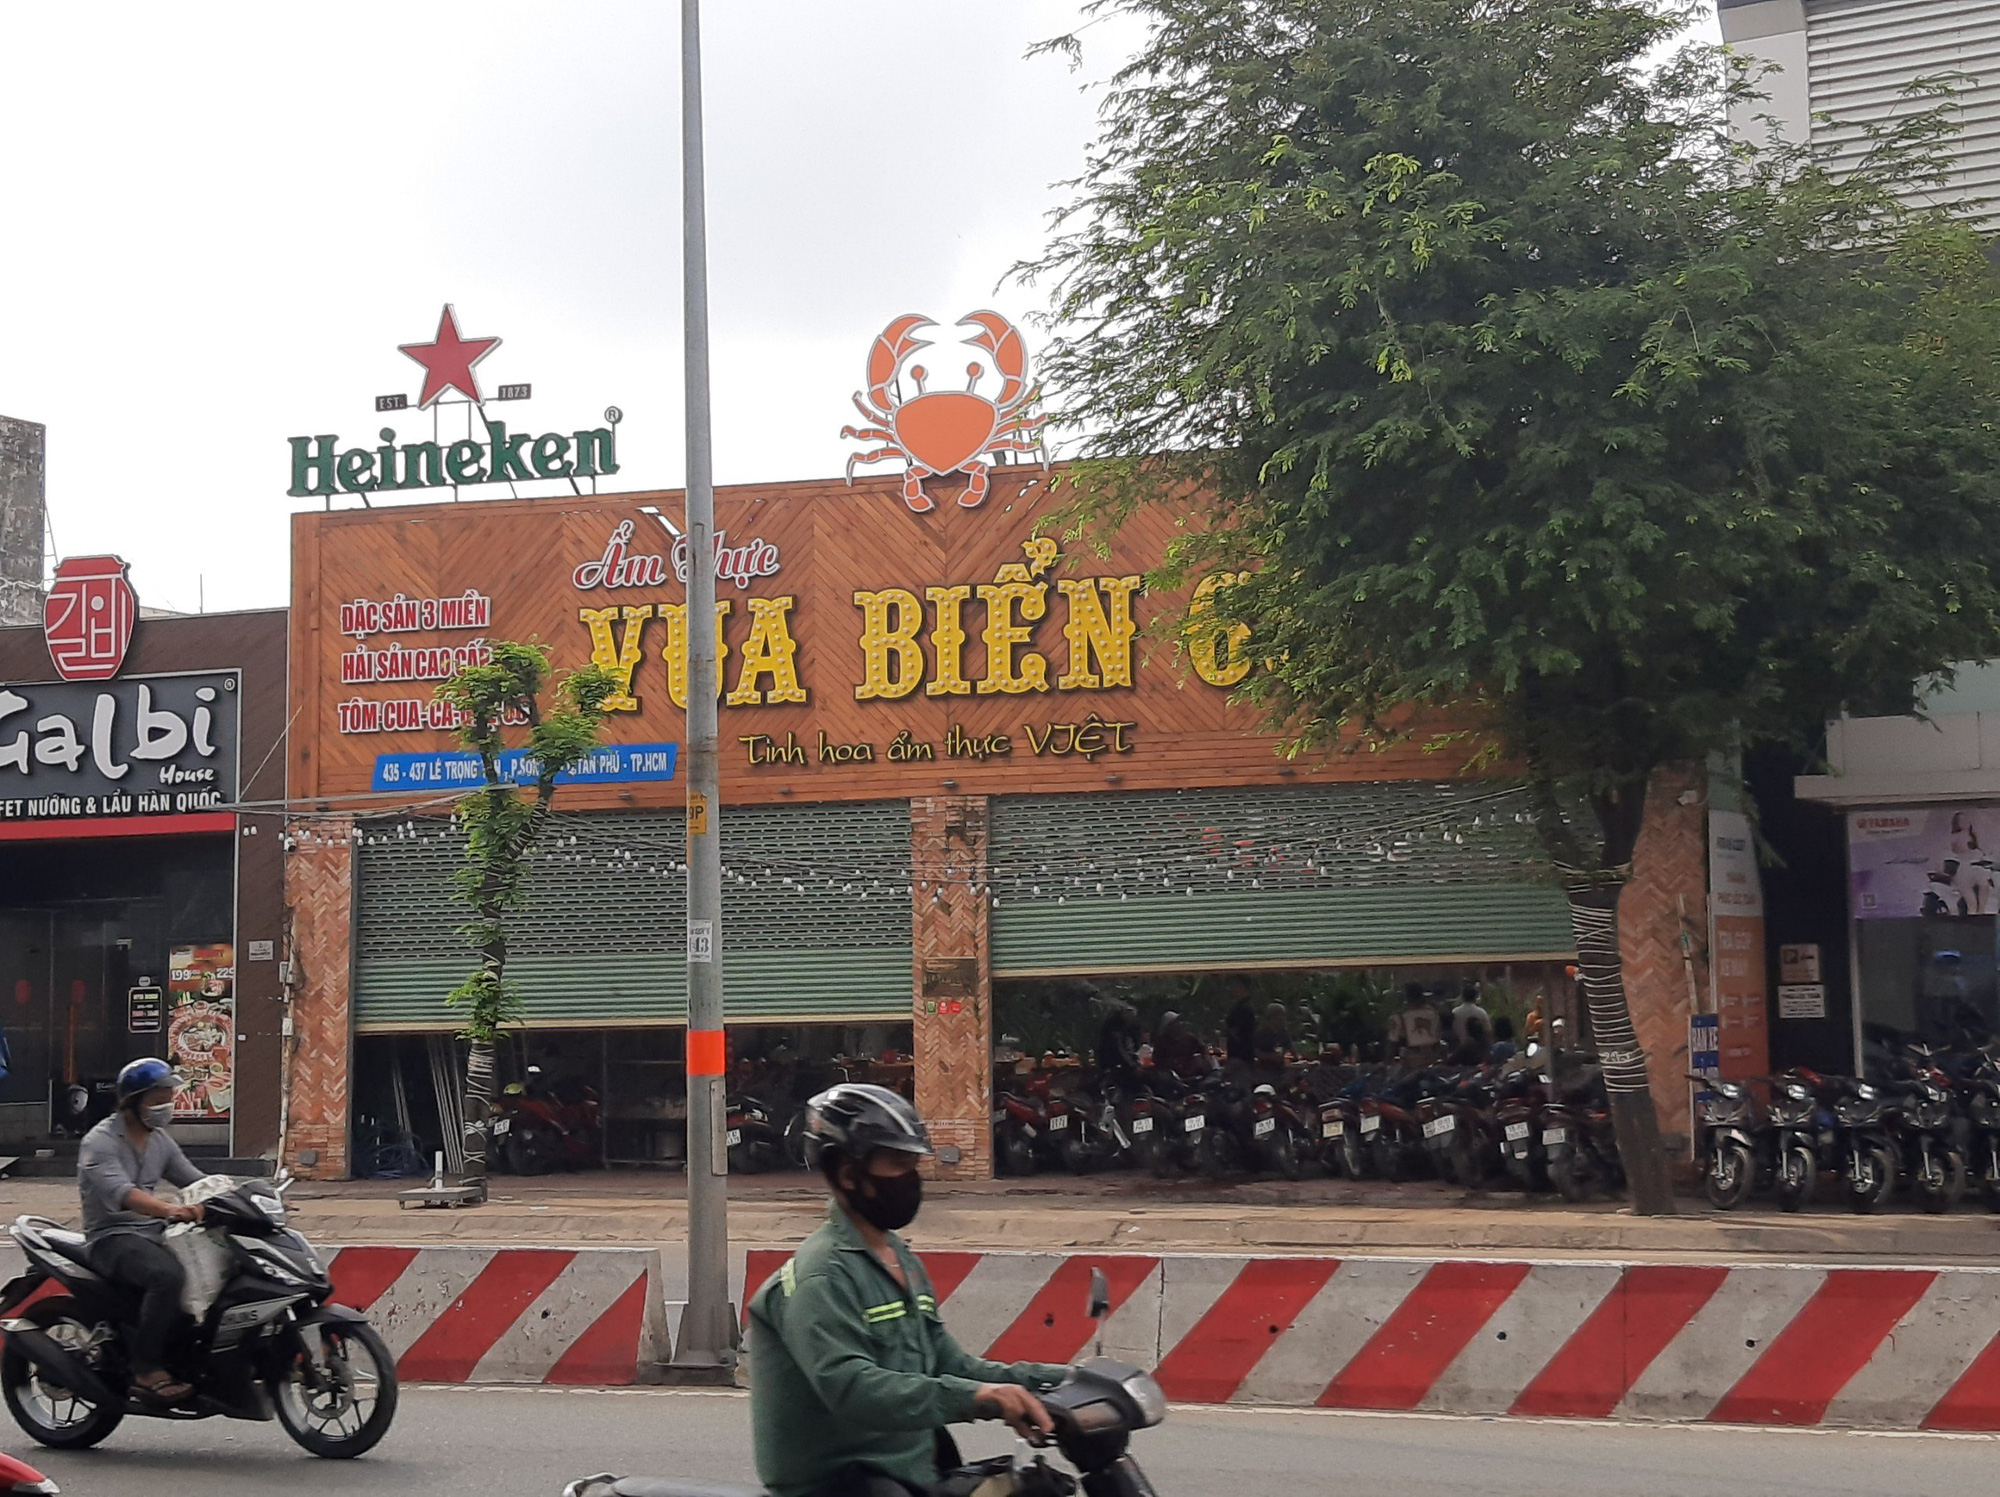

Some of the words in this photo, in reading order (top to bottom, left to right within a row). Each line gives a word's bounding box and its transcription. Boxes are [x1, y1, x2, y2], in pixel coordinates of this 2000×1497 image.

[501, 386, 528, 399] 1873
[287, 421, 620, 497] Heineken
[380, 593, 420, 632] SẢN
[422, 599, 437, 630] 3
[439, 589, 491, 629] MIỀN
[853, 537, 1141, 700] BIỂN
[341, 644, 376, 683] HẢI
[376, 642, 413, 681] SẢN
[414, 647, 452, 679] CAO
[818, 731, 873, 763] hoa
[886, 730, 932, 762] ẩm
[944, 724, 1013, 760] thực
[159, 764, 214, 785] House
[383, 763, 399, 782] 435
[409, 762, 426, 781] 437
[445, 760, 479, 784] TRỌNG
[630, 752, 667, 773] TP.HCM
[28, 794, 81, 816] NƯỚNG
[86, 797, 97, 815] &
[103, 788, 131, 813] LẨU
[138, 790, 170, 812] HÀN
